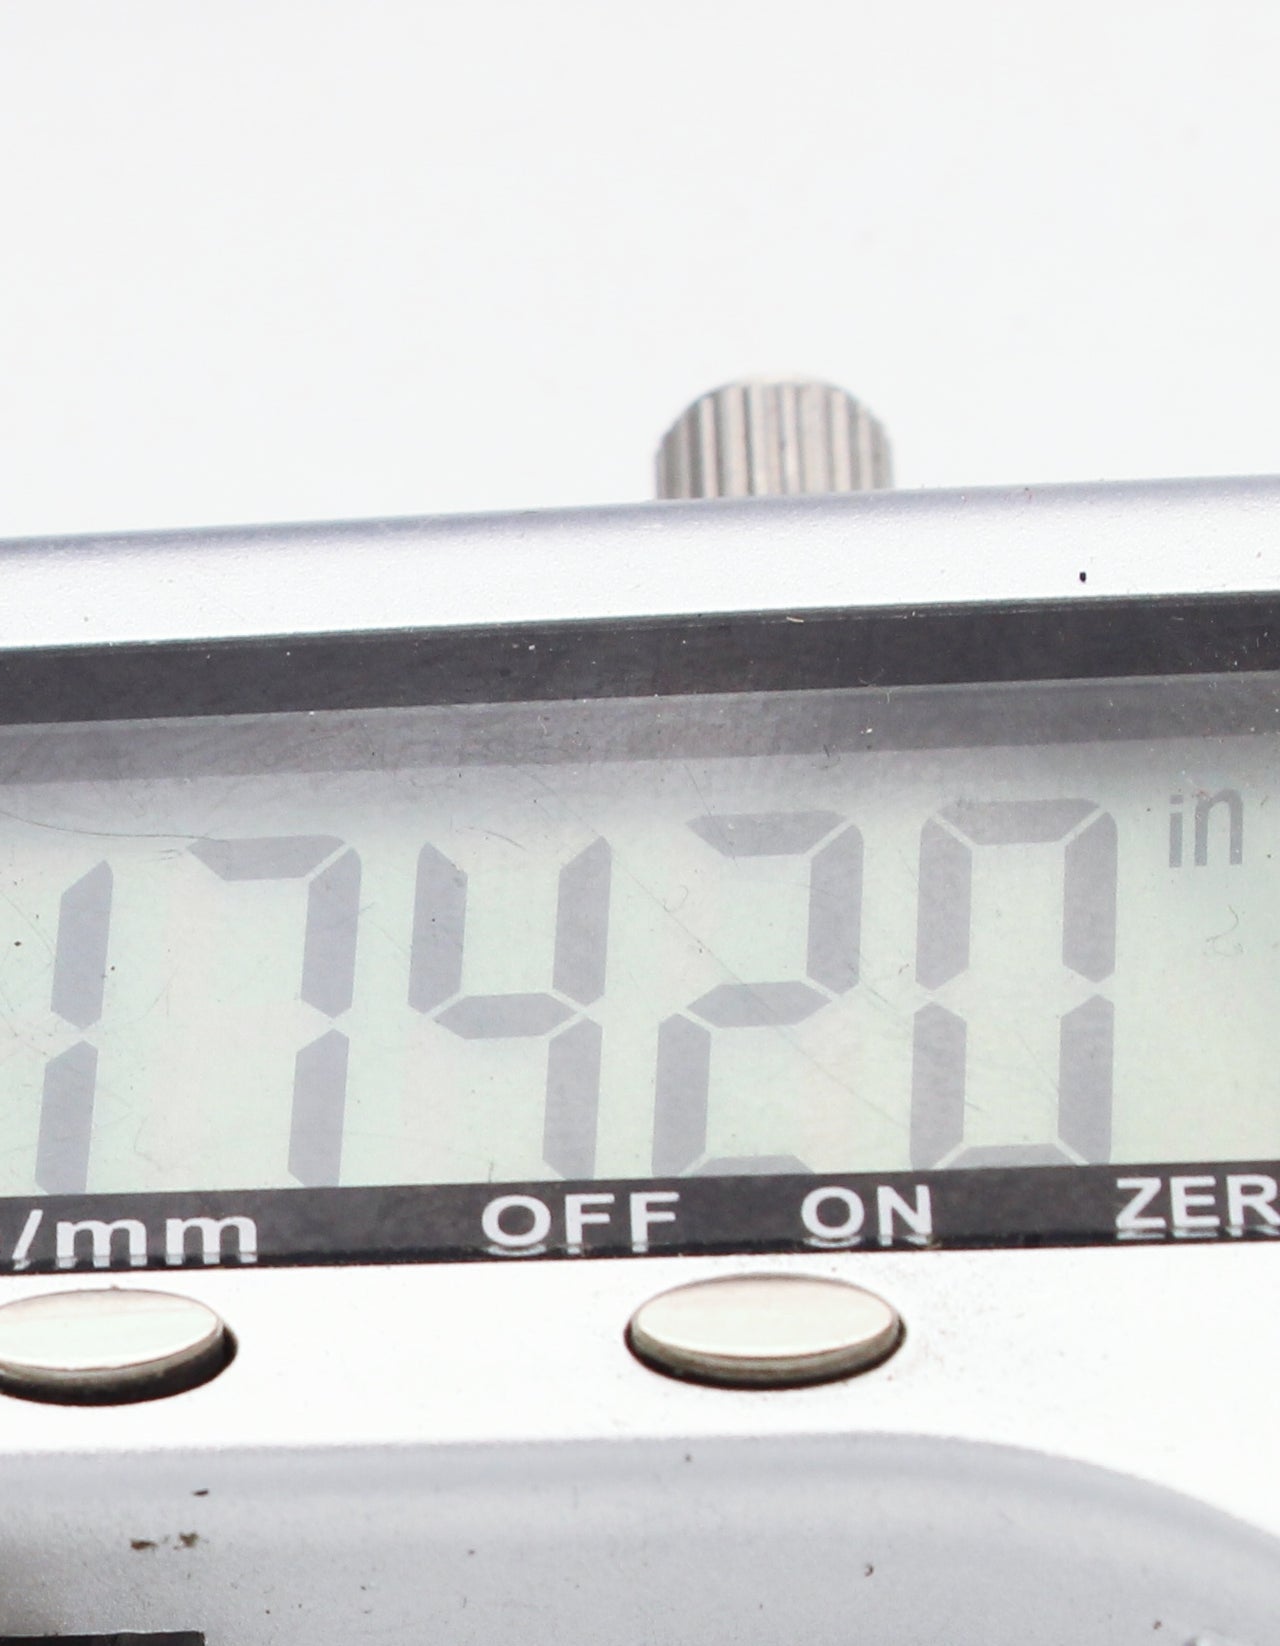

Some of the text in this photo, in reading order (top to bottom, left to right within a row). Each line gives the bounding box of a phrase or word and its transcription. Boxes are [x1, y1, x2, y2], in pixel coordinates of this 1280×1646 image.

[1168, 788, 1244, 868] in
[481, 1191, 680, 1251] OFF
[801, 1184, 934, 1244] ON
